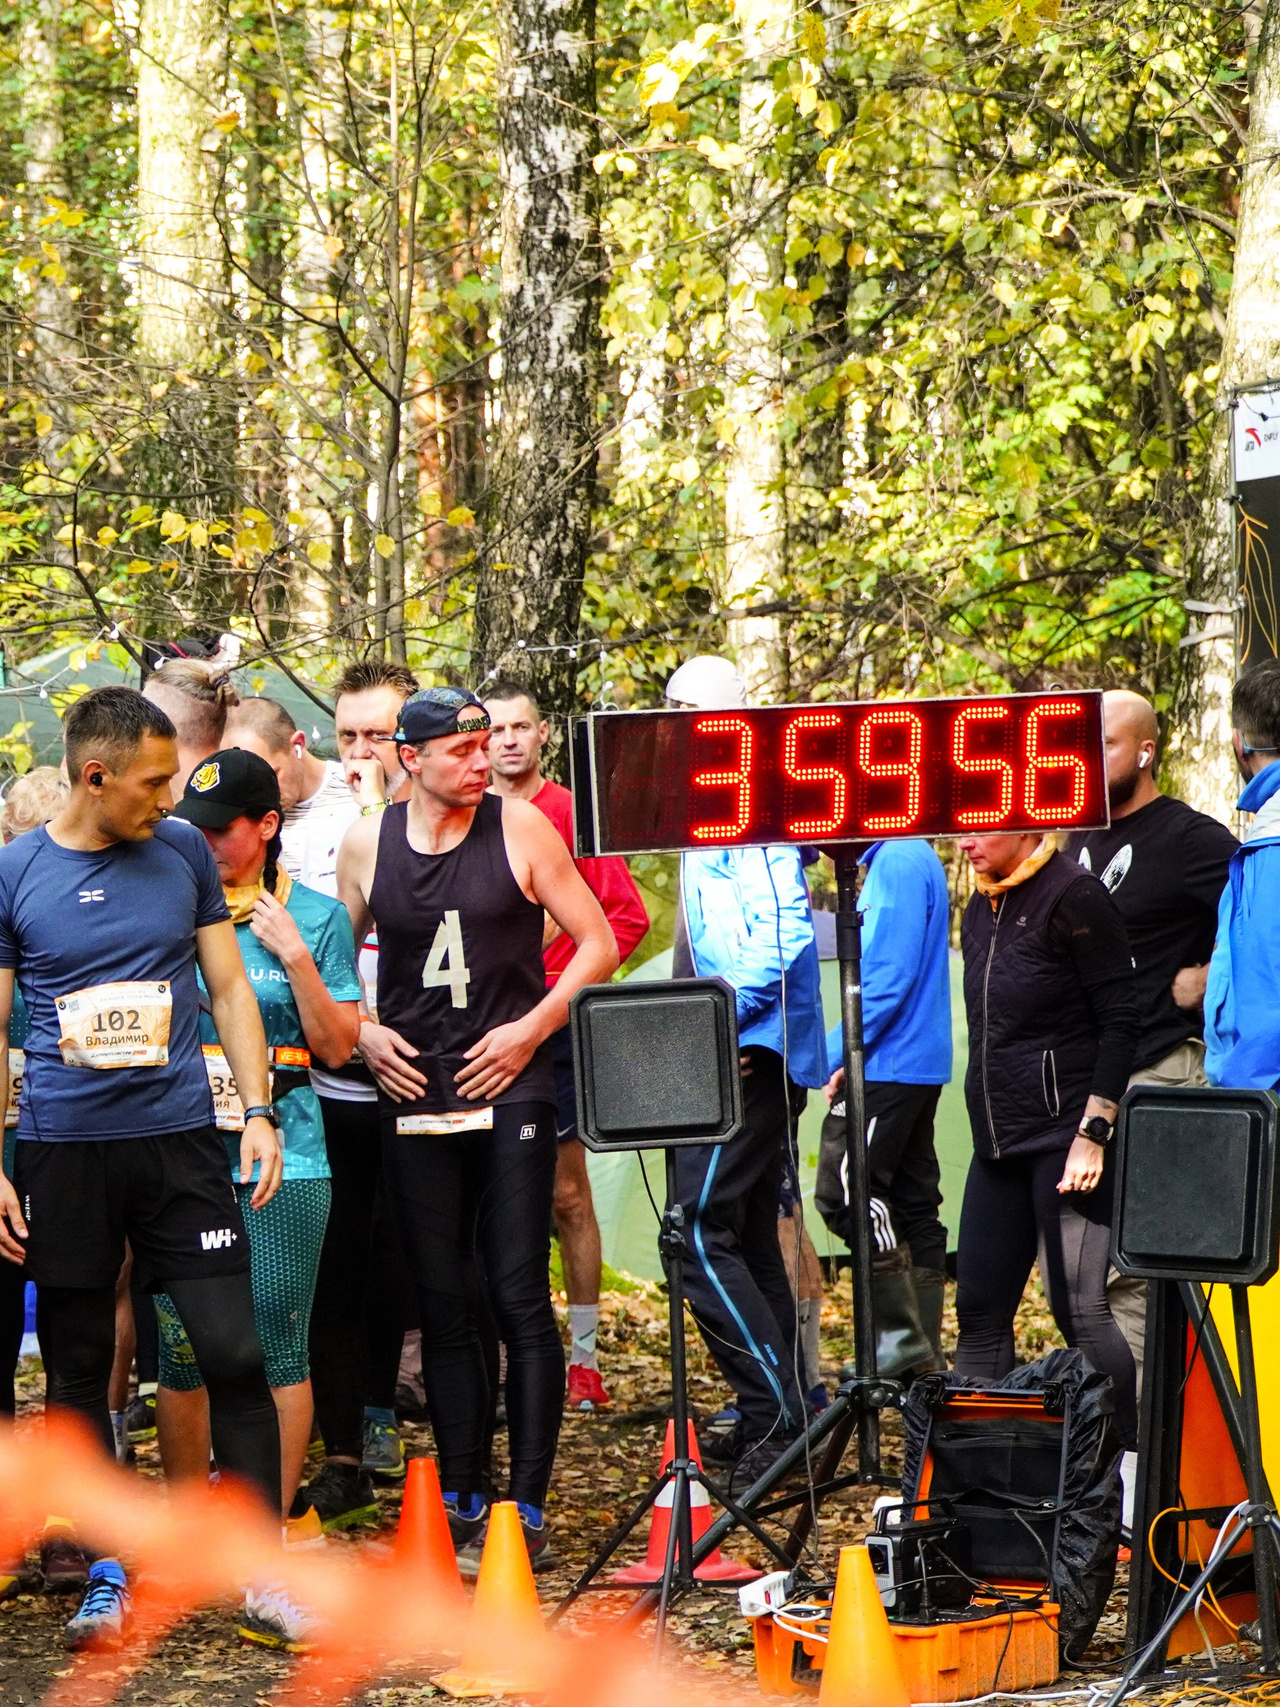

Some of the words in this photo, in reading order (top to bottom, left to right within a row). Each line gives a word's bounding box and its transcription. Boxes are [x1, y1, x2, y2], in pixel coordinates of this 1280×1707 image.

[421, 909, 471, 1009] 4
[92, 1009, 142, 1033] 102
[85, 1034, 149, 1047] Владимир
